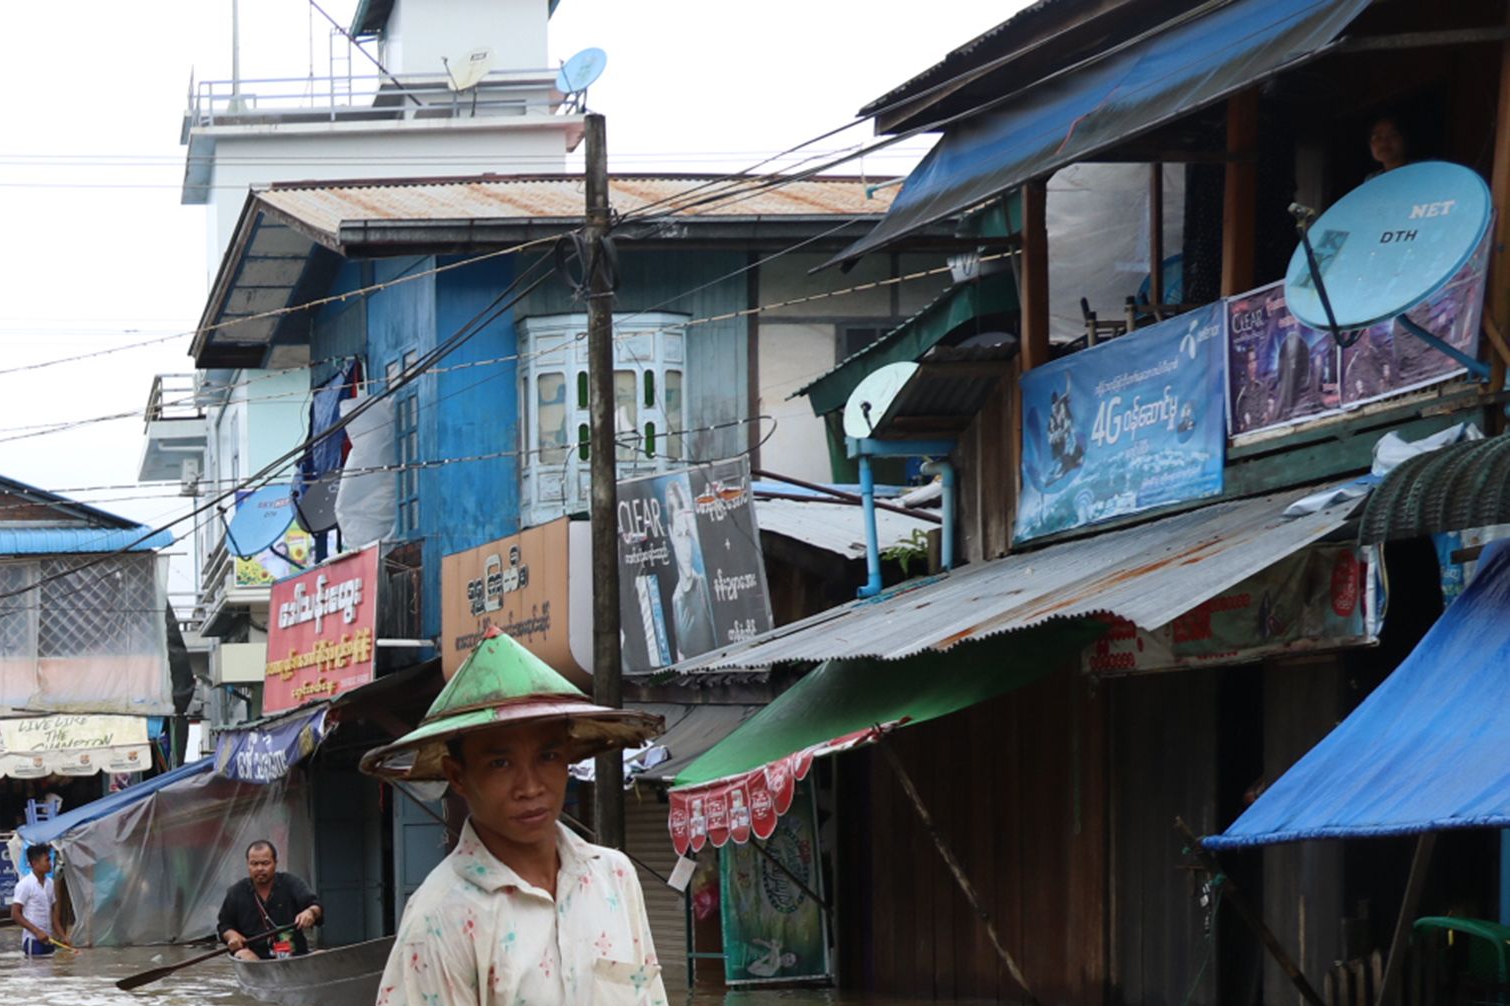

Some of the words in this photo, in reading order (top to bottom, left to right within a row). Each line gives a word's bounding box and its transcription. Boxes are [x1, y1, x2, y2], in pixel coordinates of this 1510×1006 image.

[1408, 199, 1456, 220] NET
[1379, 229, 1419, 244] DTH
[1231, 308, 1265, 334] CLEAR
[1091, 396, 1122, 447] 4G
[18, 717, 52, 733] LIVE
[44, 730, 67, 743] THE
